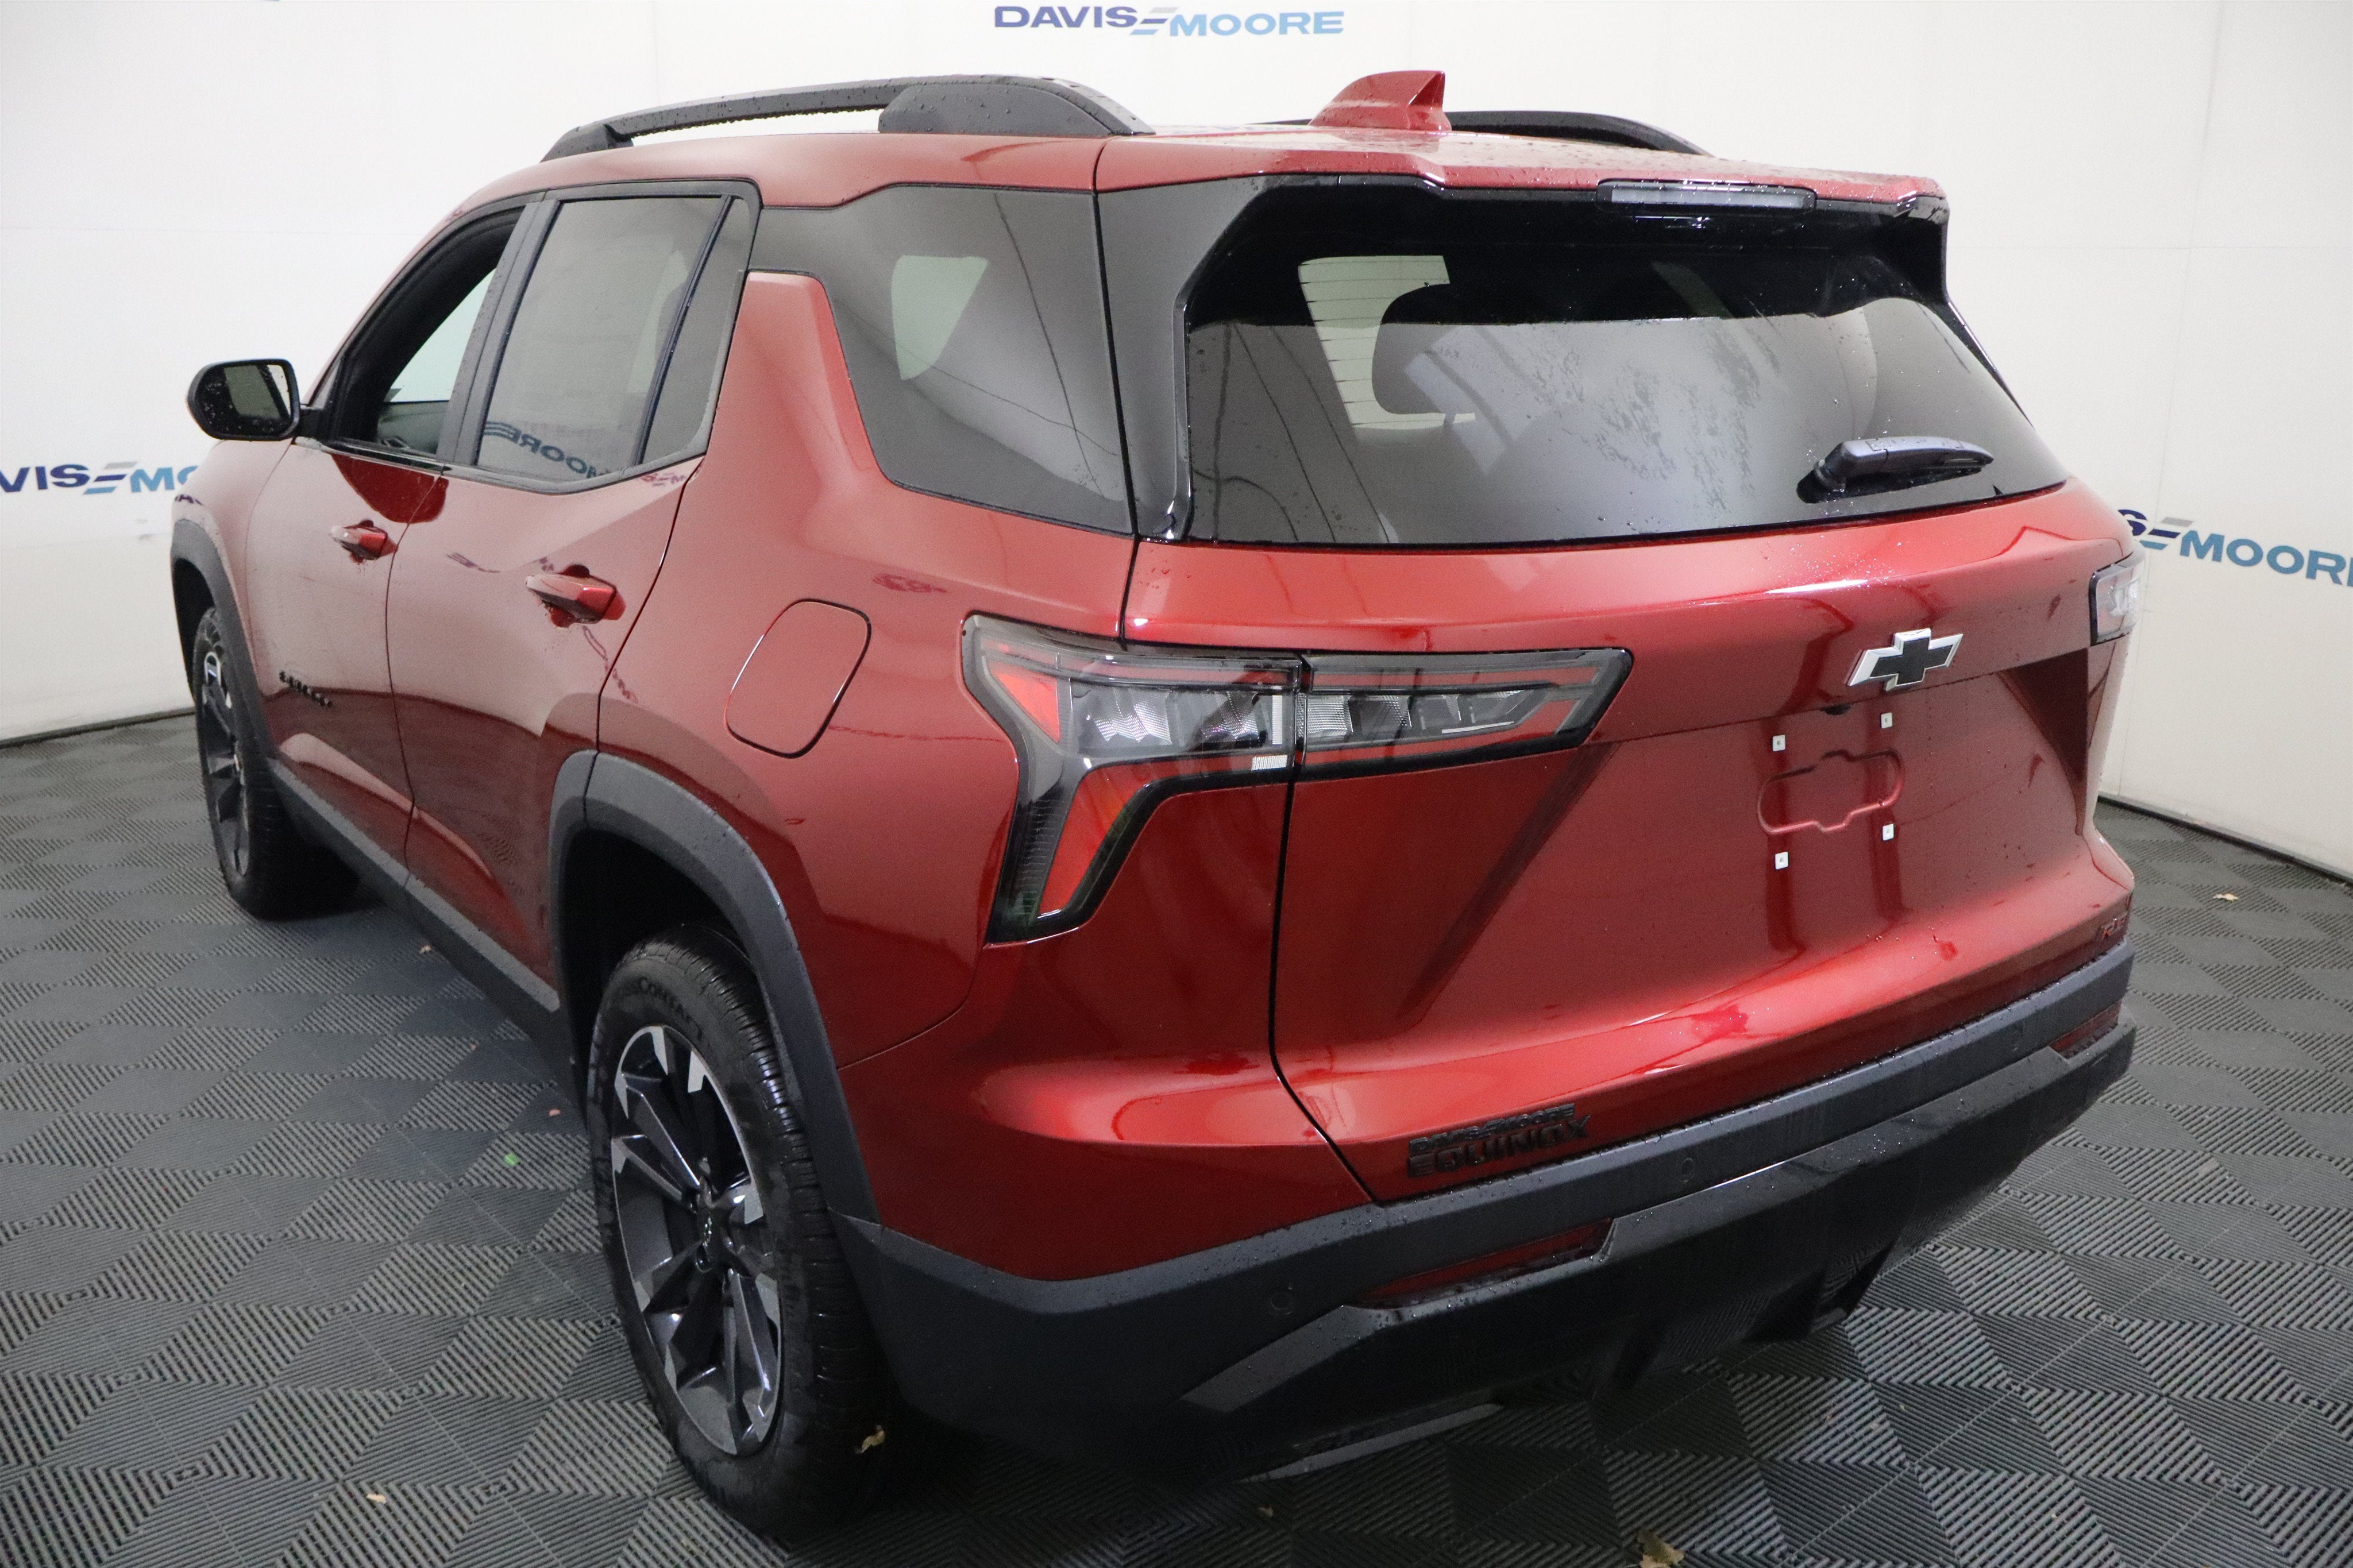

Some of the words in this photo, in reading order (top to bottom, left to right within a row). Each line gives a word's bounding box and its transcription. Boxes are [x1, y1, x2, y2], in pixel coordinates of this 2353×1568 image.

[994, 6, 1137, 28] DAVIS
[1169, 11, 1344, 36] MOORE
[2180, 530, 2353, 588] MOOR
[1407, 1115, 1591, 1177] EQUINOX
